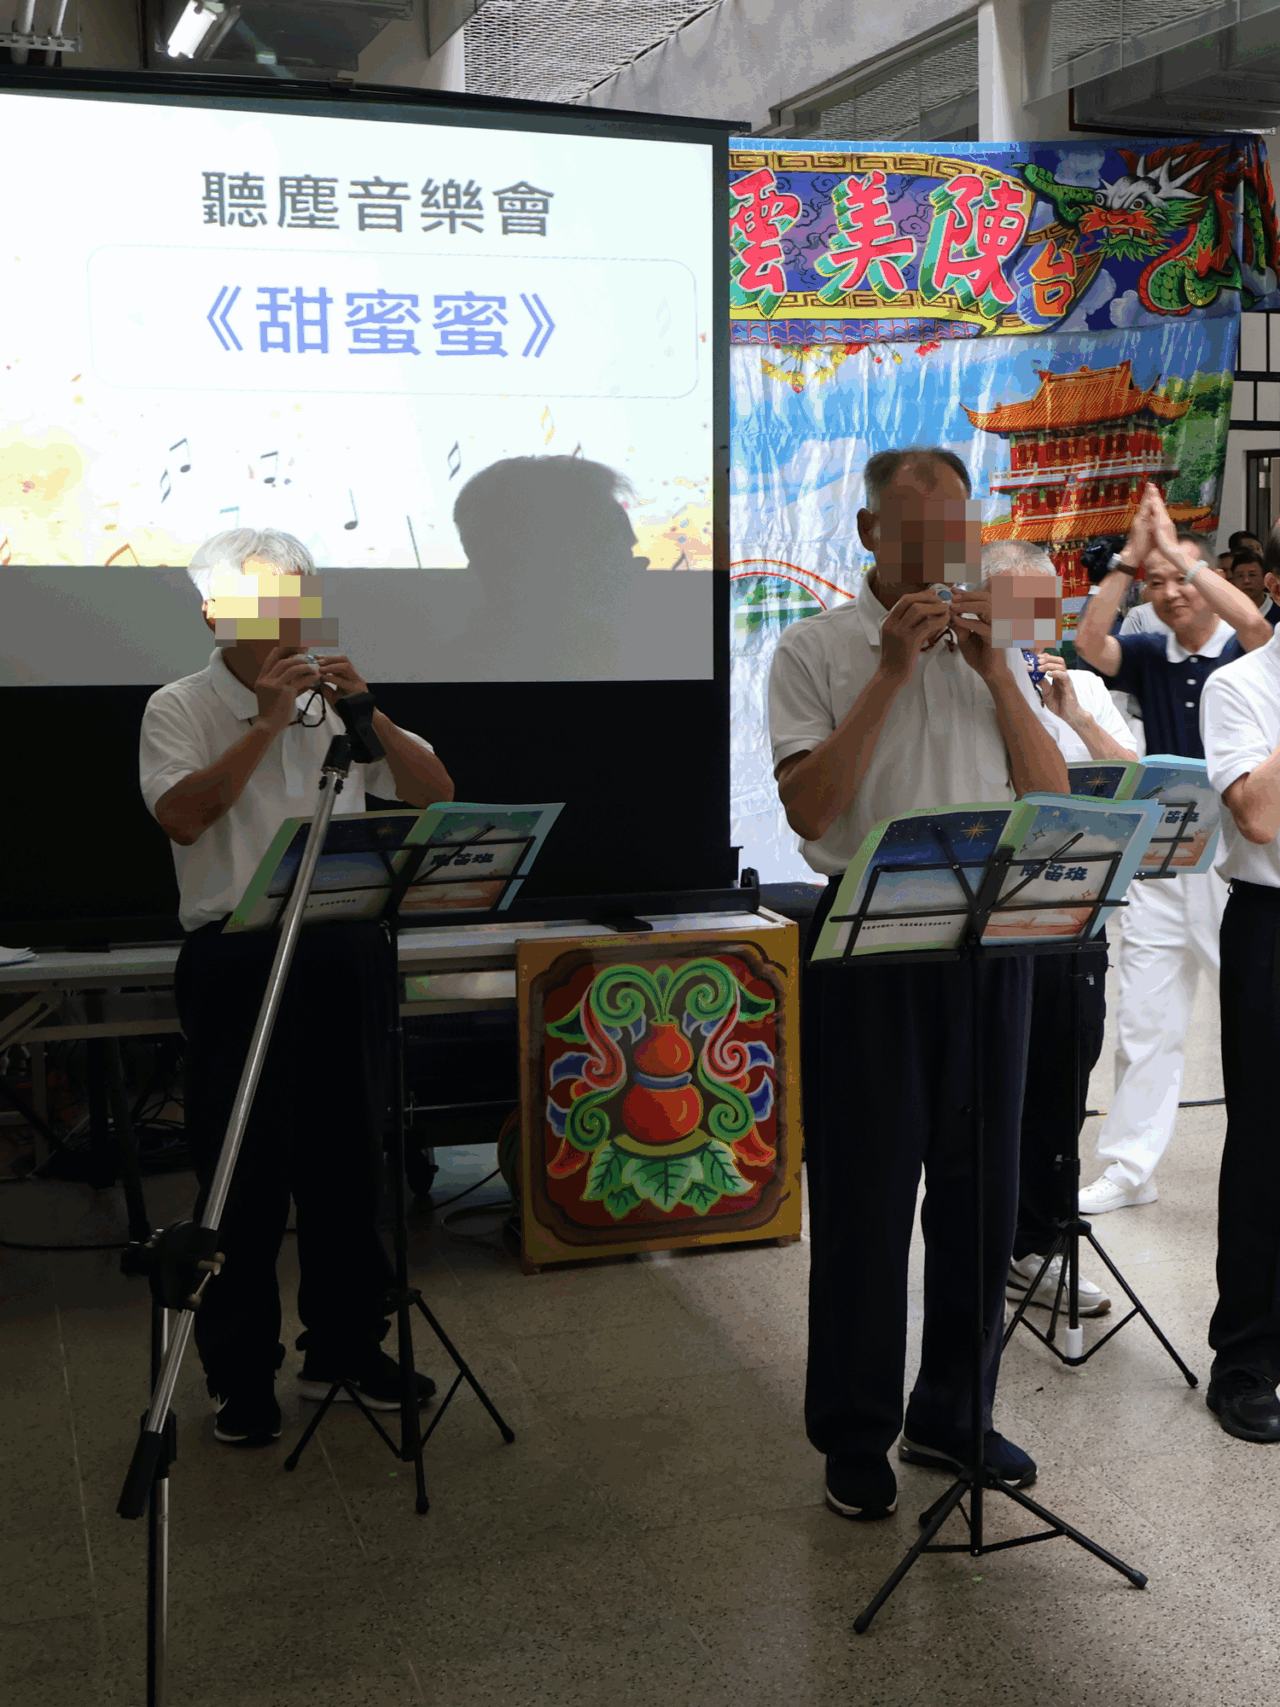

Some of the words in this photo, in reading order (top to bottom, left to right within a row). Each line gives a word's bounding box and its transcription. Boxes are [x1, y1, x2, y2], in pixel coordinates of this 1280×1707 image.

[202, 172, 555, 237] 聽塵音樂會
[206, 285, 556, 358] 《甜蜜蜜》
